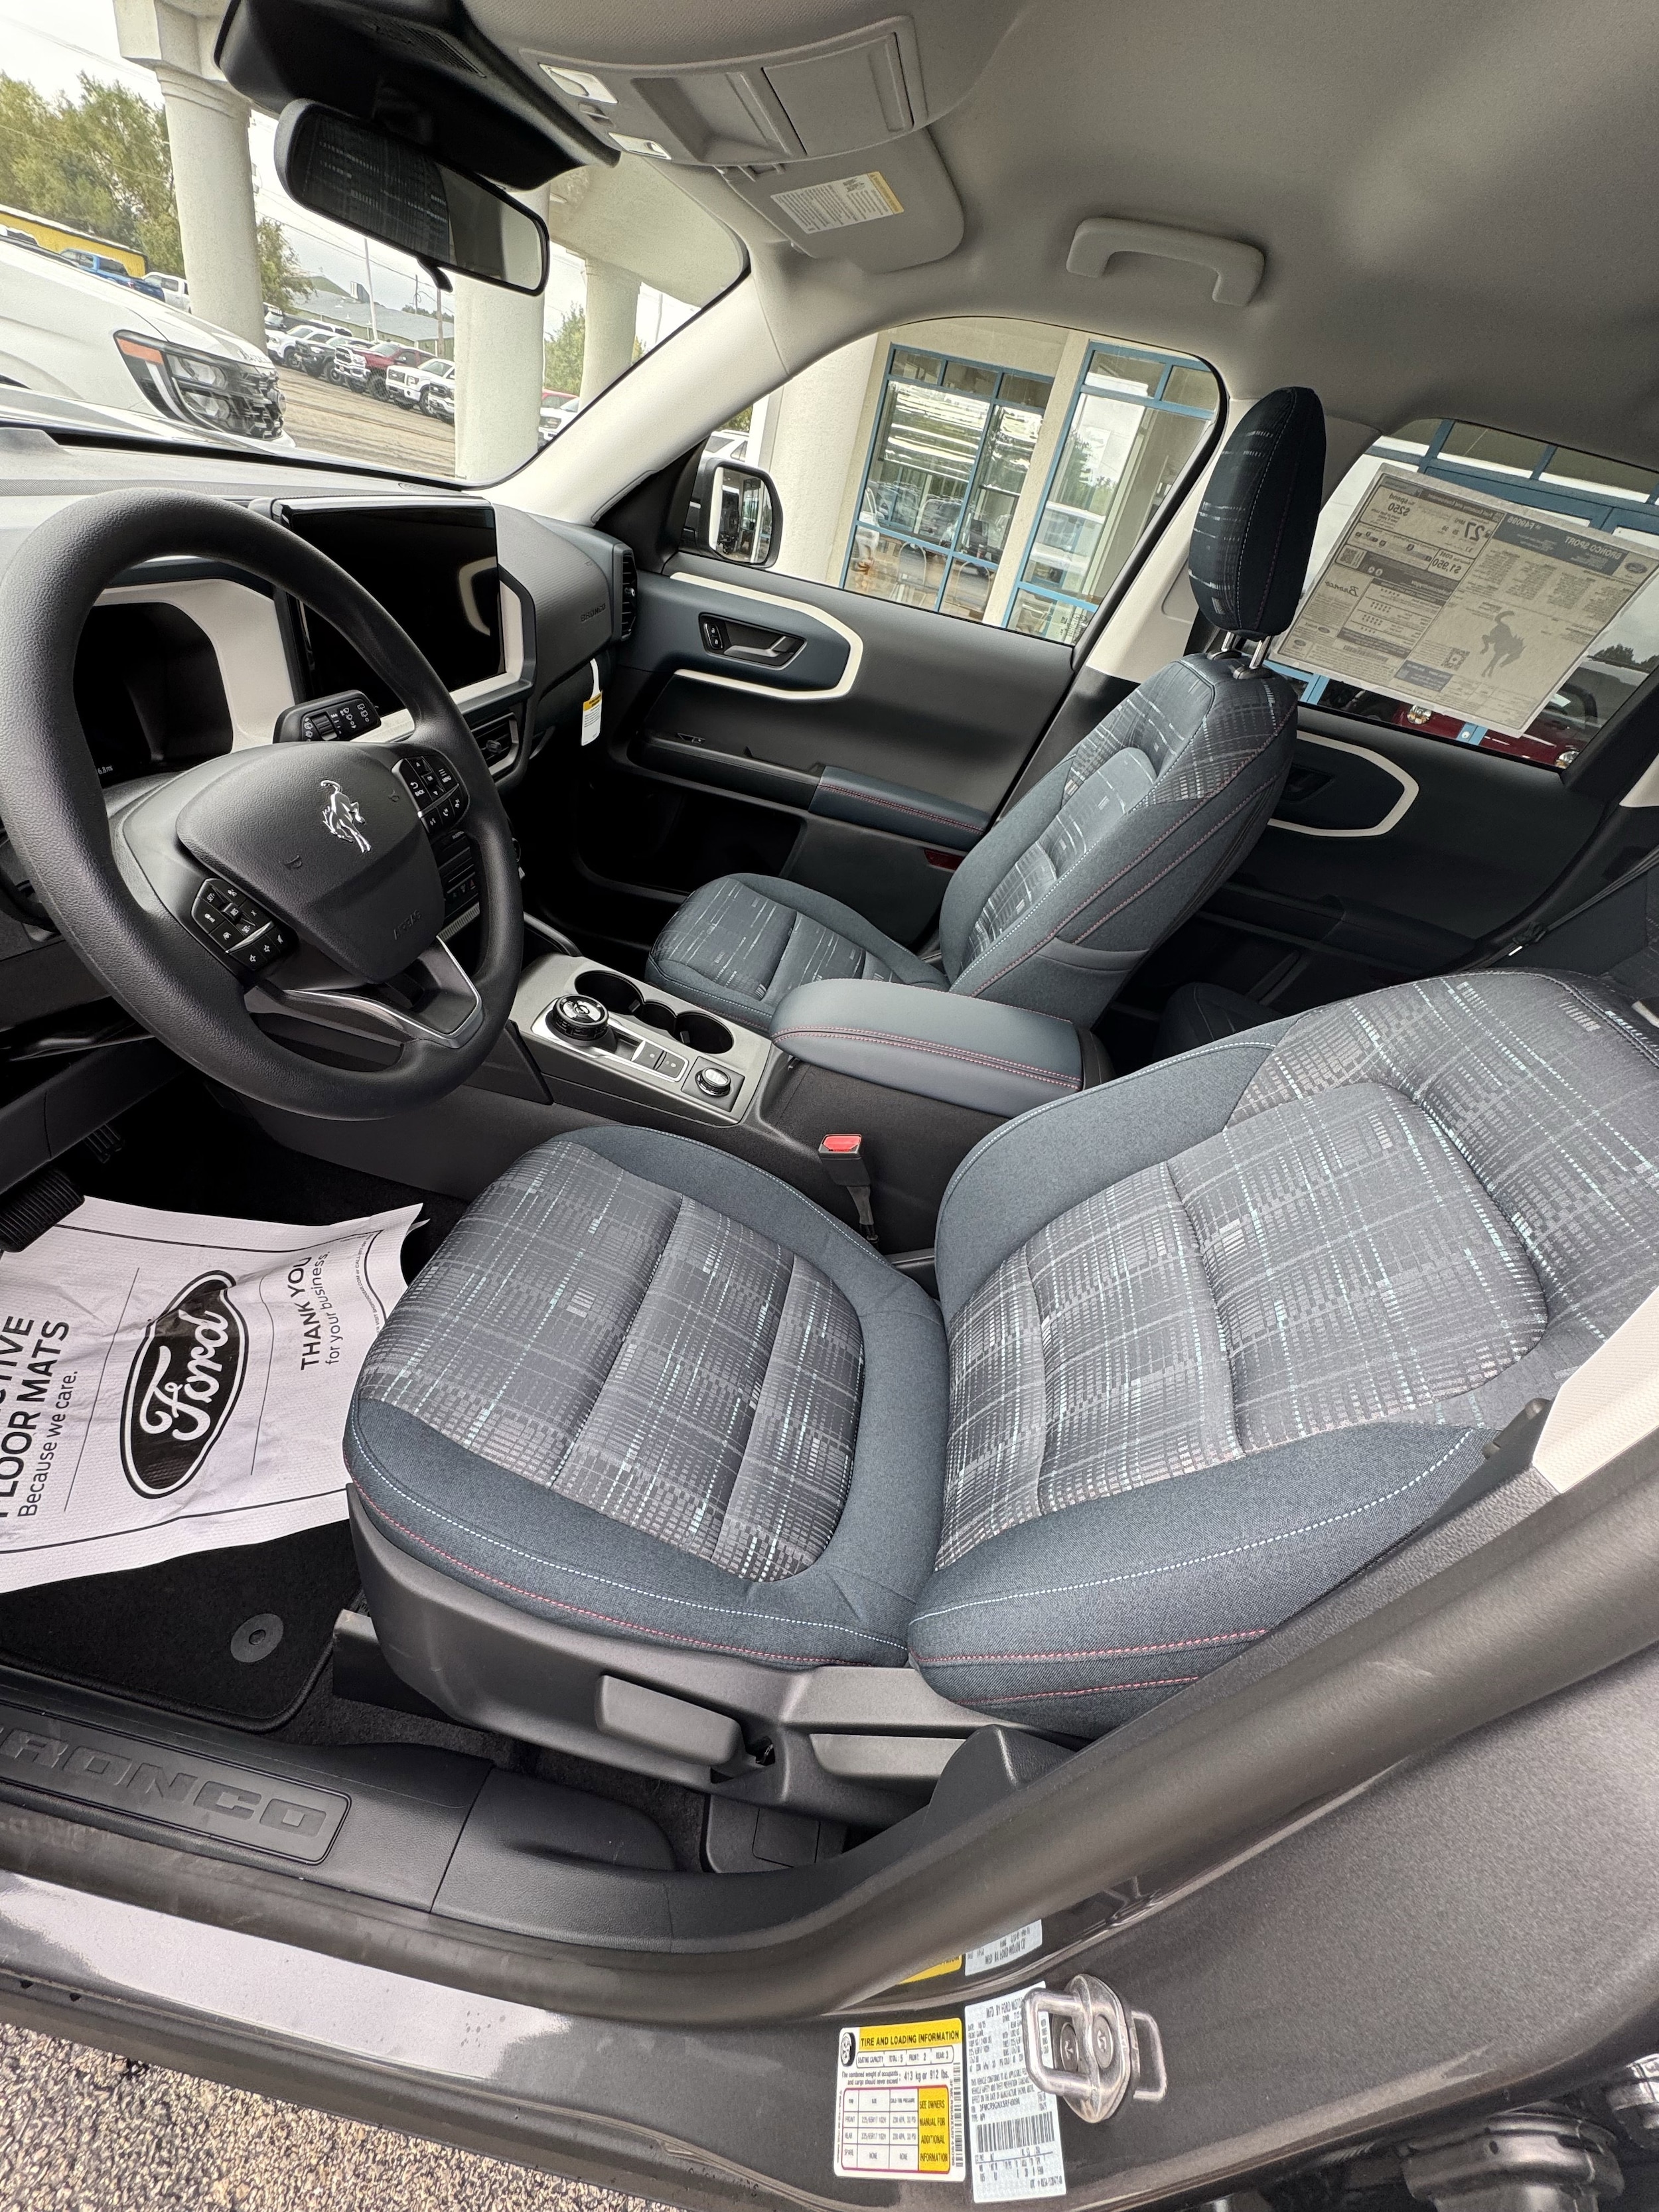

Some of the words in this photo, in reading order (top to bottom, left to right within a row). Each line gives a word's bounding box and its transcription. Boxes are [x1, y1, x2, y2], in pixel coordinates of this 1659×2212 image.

[287, 1257, 312, 1297] YOU
[311, 1252, 333, 1310] business.
[294, 1301, 322, 1370] THANK
[326, 1313, 343, 1343] your
[16, 1321, 69, 1402] MATS
[325, 1347, 340, 1364] for
[56, 1371, 78, 1409] care.
[139, 1309, 228, 1441] Ford
[47, 1413, 66, 1438] we
[0, 1411, 40, 1518] LOOR
[18, 1441, 58, 1517] Because
[0, 1728, 326, 1838] RONCO
[861, 2037, 874, 2047] TIRE
[876, 2036, 889, 2045] AND
[890, 2034, 916, 2044] LOADING
[918, 2030, 960, 2043] INFORMATION
[865, 2070, 877, 2079] weight
[881, 2070, 899, 2079] occupants
[904, 2071, 913, 2081] 413
[915, 2071, 921, 2083] kg
[930, 2069, 939, 2079] 912
[928, 2099, 945, 2108] OWNERS
[920, 2117, 936, 2126] MANUAL
[937, 2117, 946, 2126] FOR
[921, 2134, 945, 2144] ADDITIONAL
[920, 2153, 948, 2162] INFORMATION
